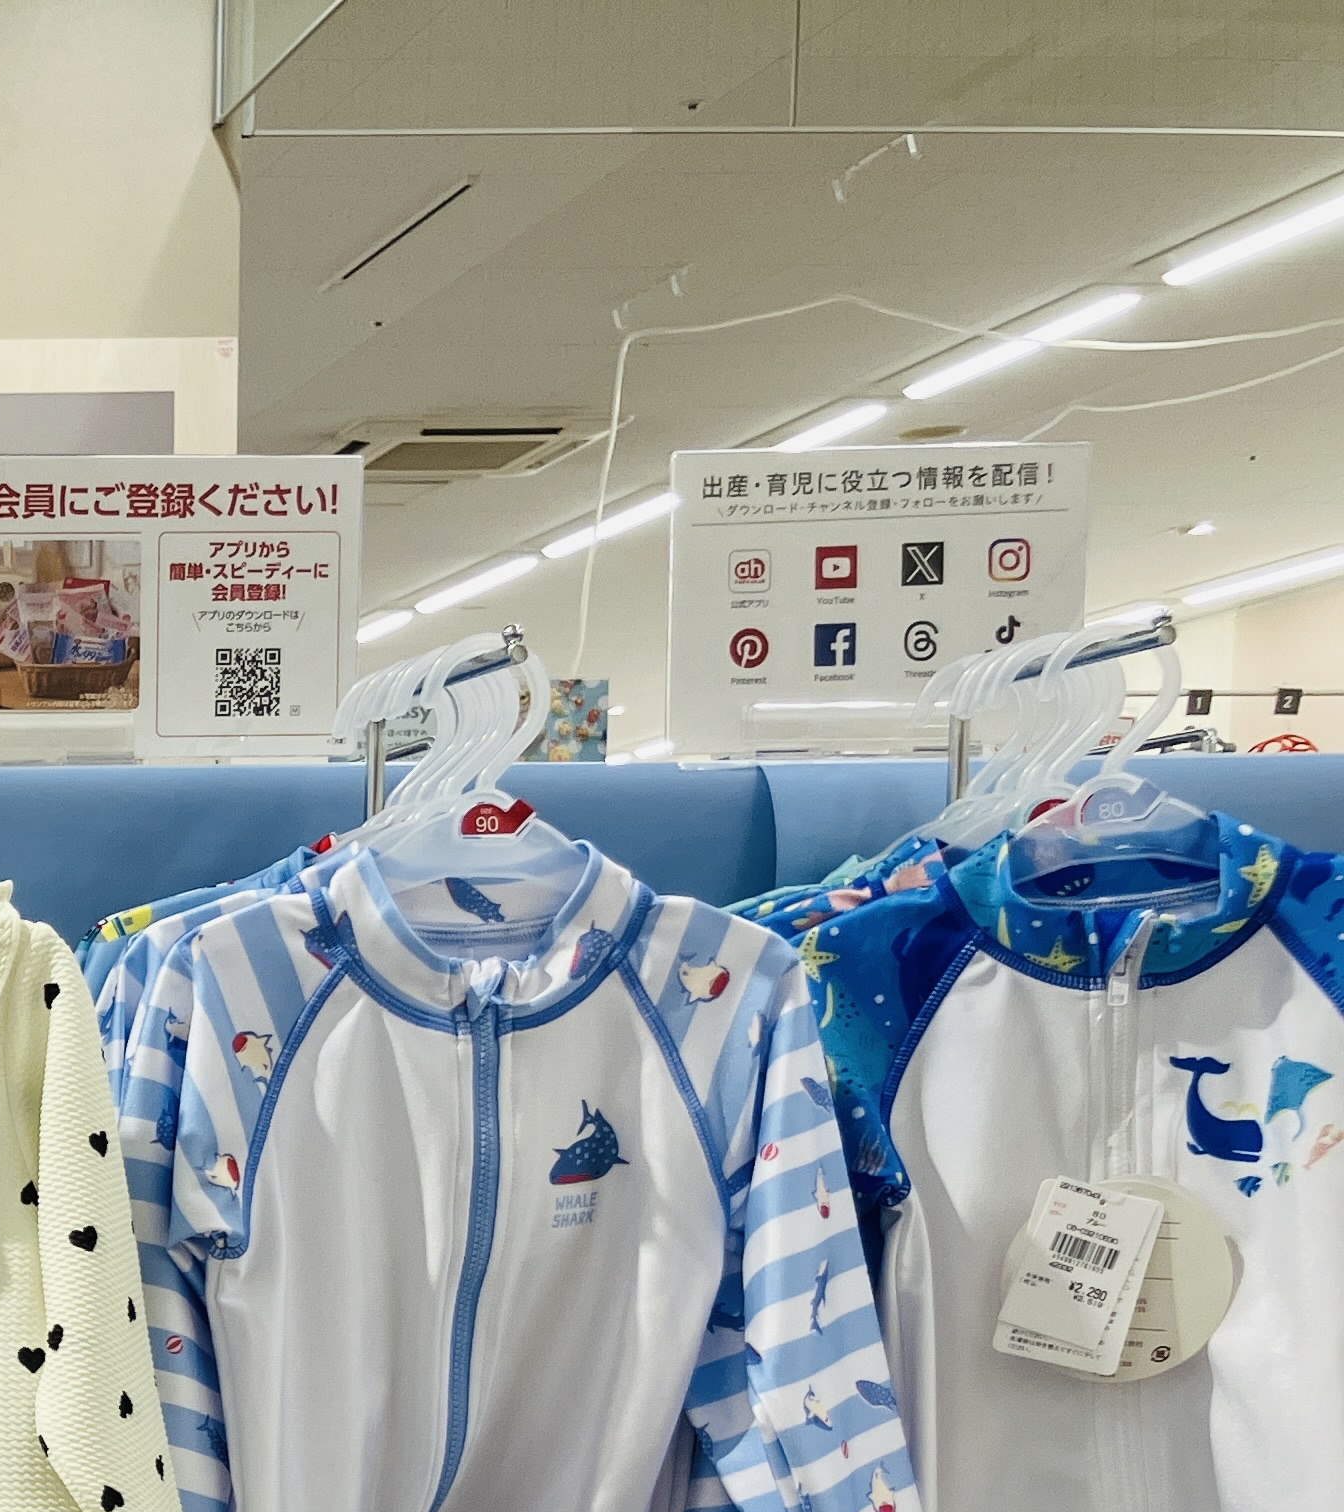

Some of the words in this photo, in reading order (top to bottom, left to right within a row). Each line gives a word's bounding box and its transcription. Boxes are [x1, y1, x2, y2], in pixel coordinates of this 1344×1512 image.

[702, 462, 1054, 499] 出産・育児に役立つ情報を配信！
[208, 541, 290, 559] アプリから
[169, 562, 330, 581] 簡単・スピーディーに
[211, 583, 287, 602] 会員登録!
[816, 596, 855, 605] YouTube
[225, 622, 272, 633] こちらから
[1098, 800, 1125, 819] 80
[475, 815, 500, 833] 90
[555, 1191, 599, 1211] WHALE
[552, 1208, 594, 1228] SHARK
[1092, 1210, 1107, 1220] 80
